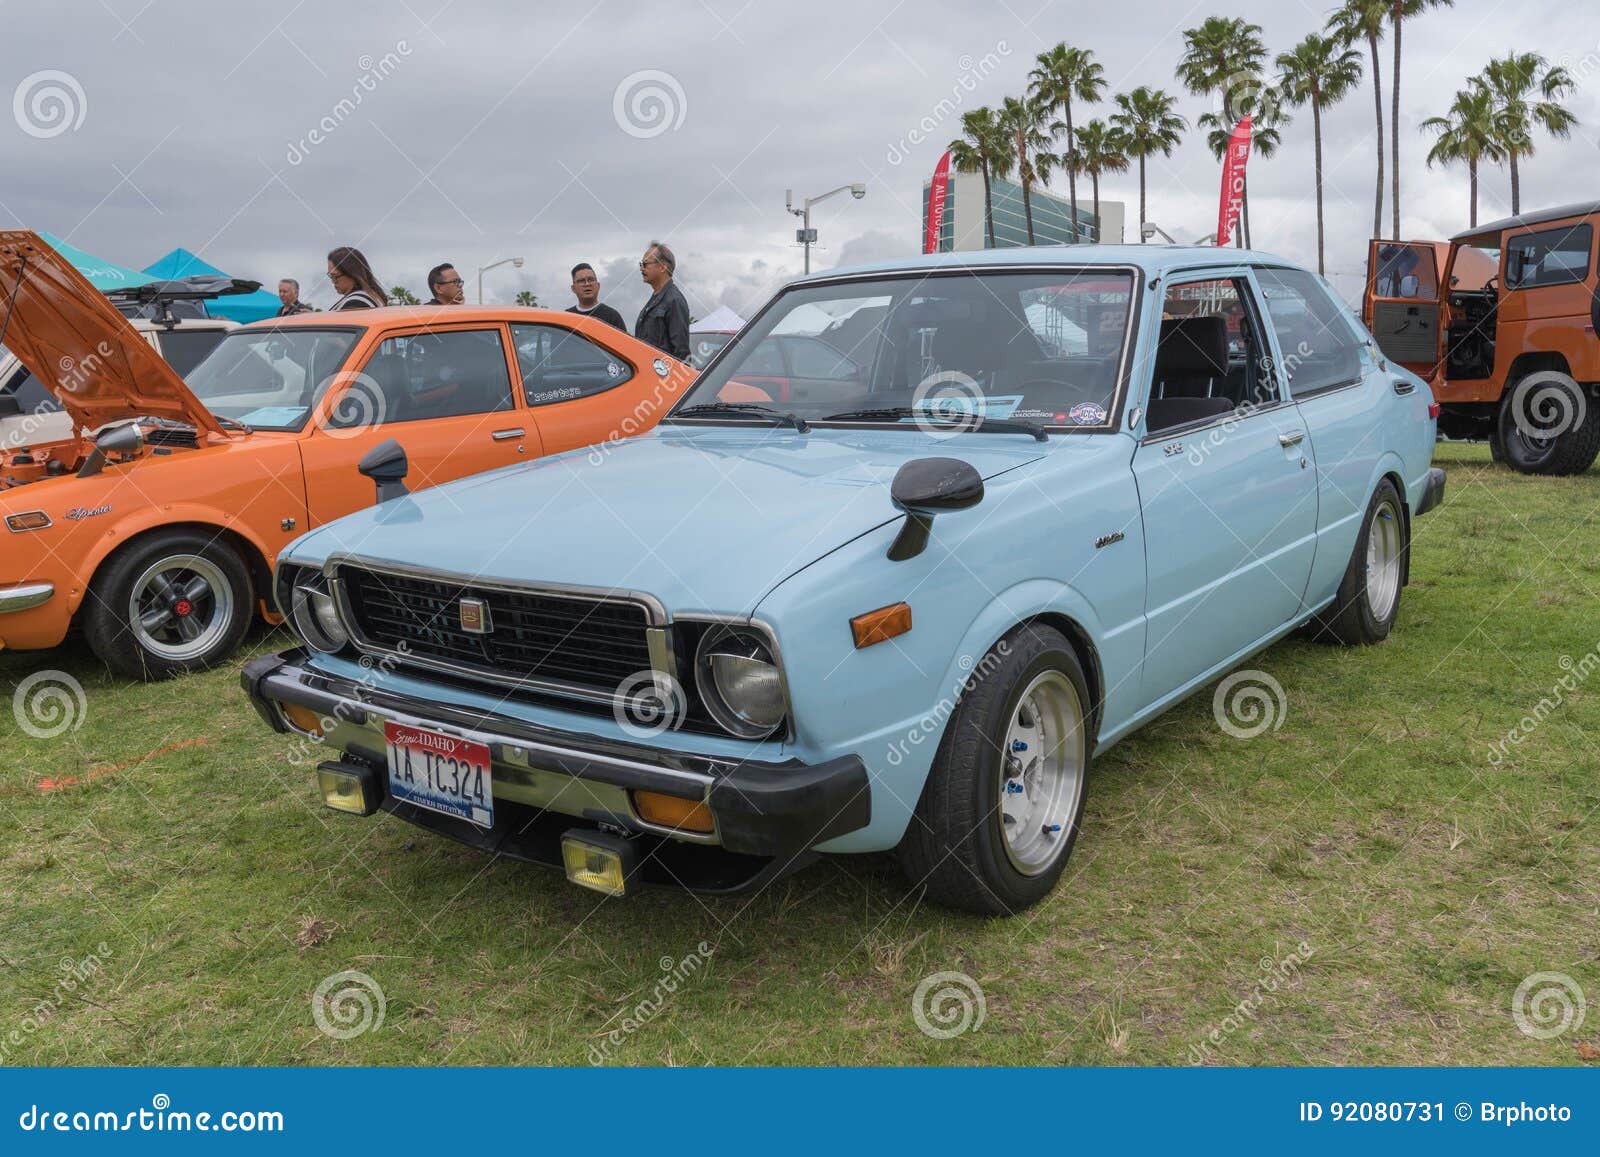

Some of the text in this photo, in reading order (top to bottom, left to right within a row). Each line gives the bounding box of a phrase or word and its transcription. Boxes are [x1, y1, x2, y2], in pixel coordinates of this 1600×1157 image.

[936, 184, 945, 201] ALL
[418, 732, 455, 753] IDAHO
[422, 750, 485, 805] TC324
